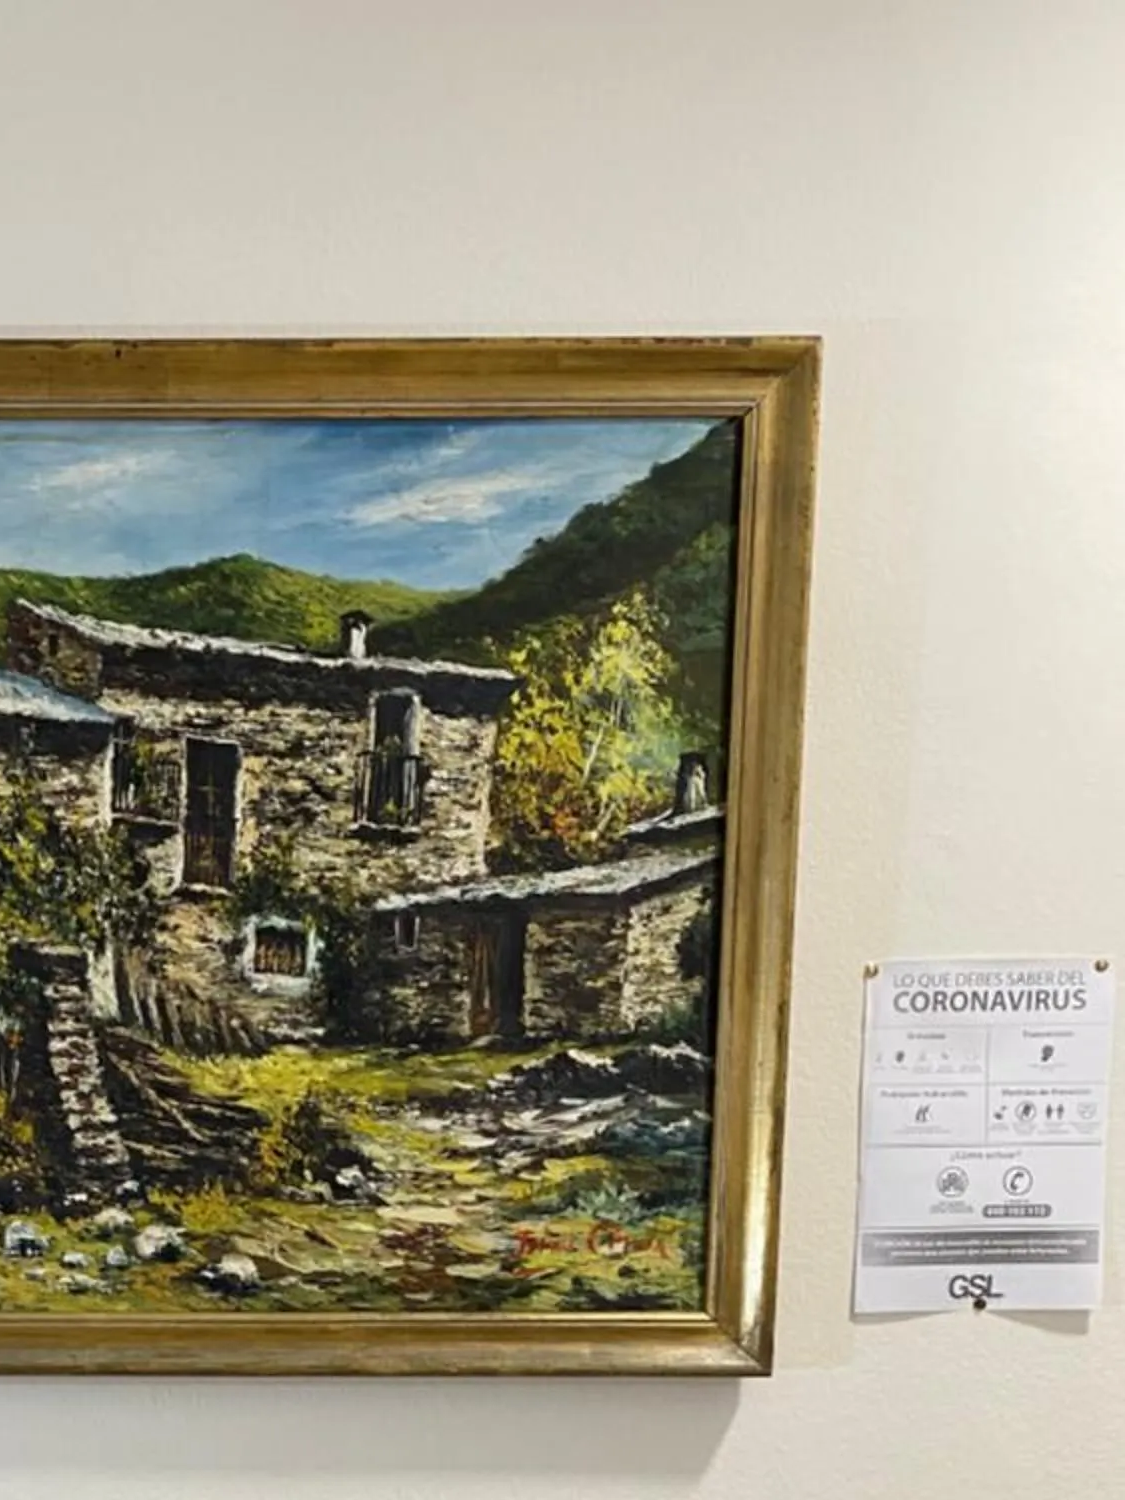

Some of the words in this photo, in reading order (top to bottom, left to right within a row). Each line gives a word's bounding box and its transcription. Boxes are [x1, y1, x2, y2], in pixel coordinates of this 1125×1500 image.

[893, 974, 915, 988] LO
[918, 973, 953, 988] QUE
[955, 972, 1003, 988] DEBES
[1007, 971, 1055, 986] SABER
[1057, 970, 1086, 985] DEL
[893, 989, 1087, 1013] CORONAVIRUS
[949, 1274, 1004, 1298] GSL
